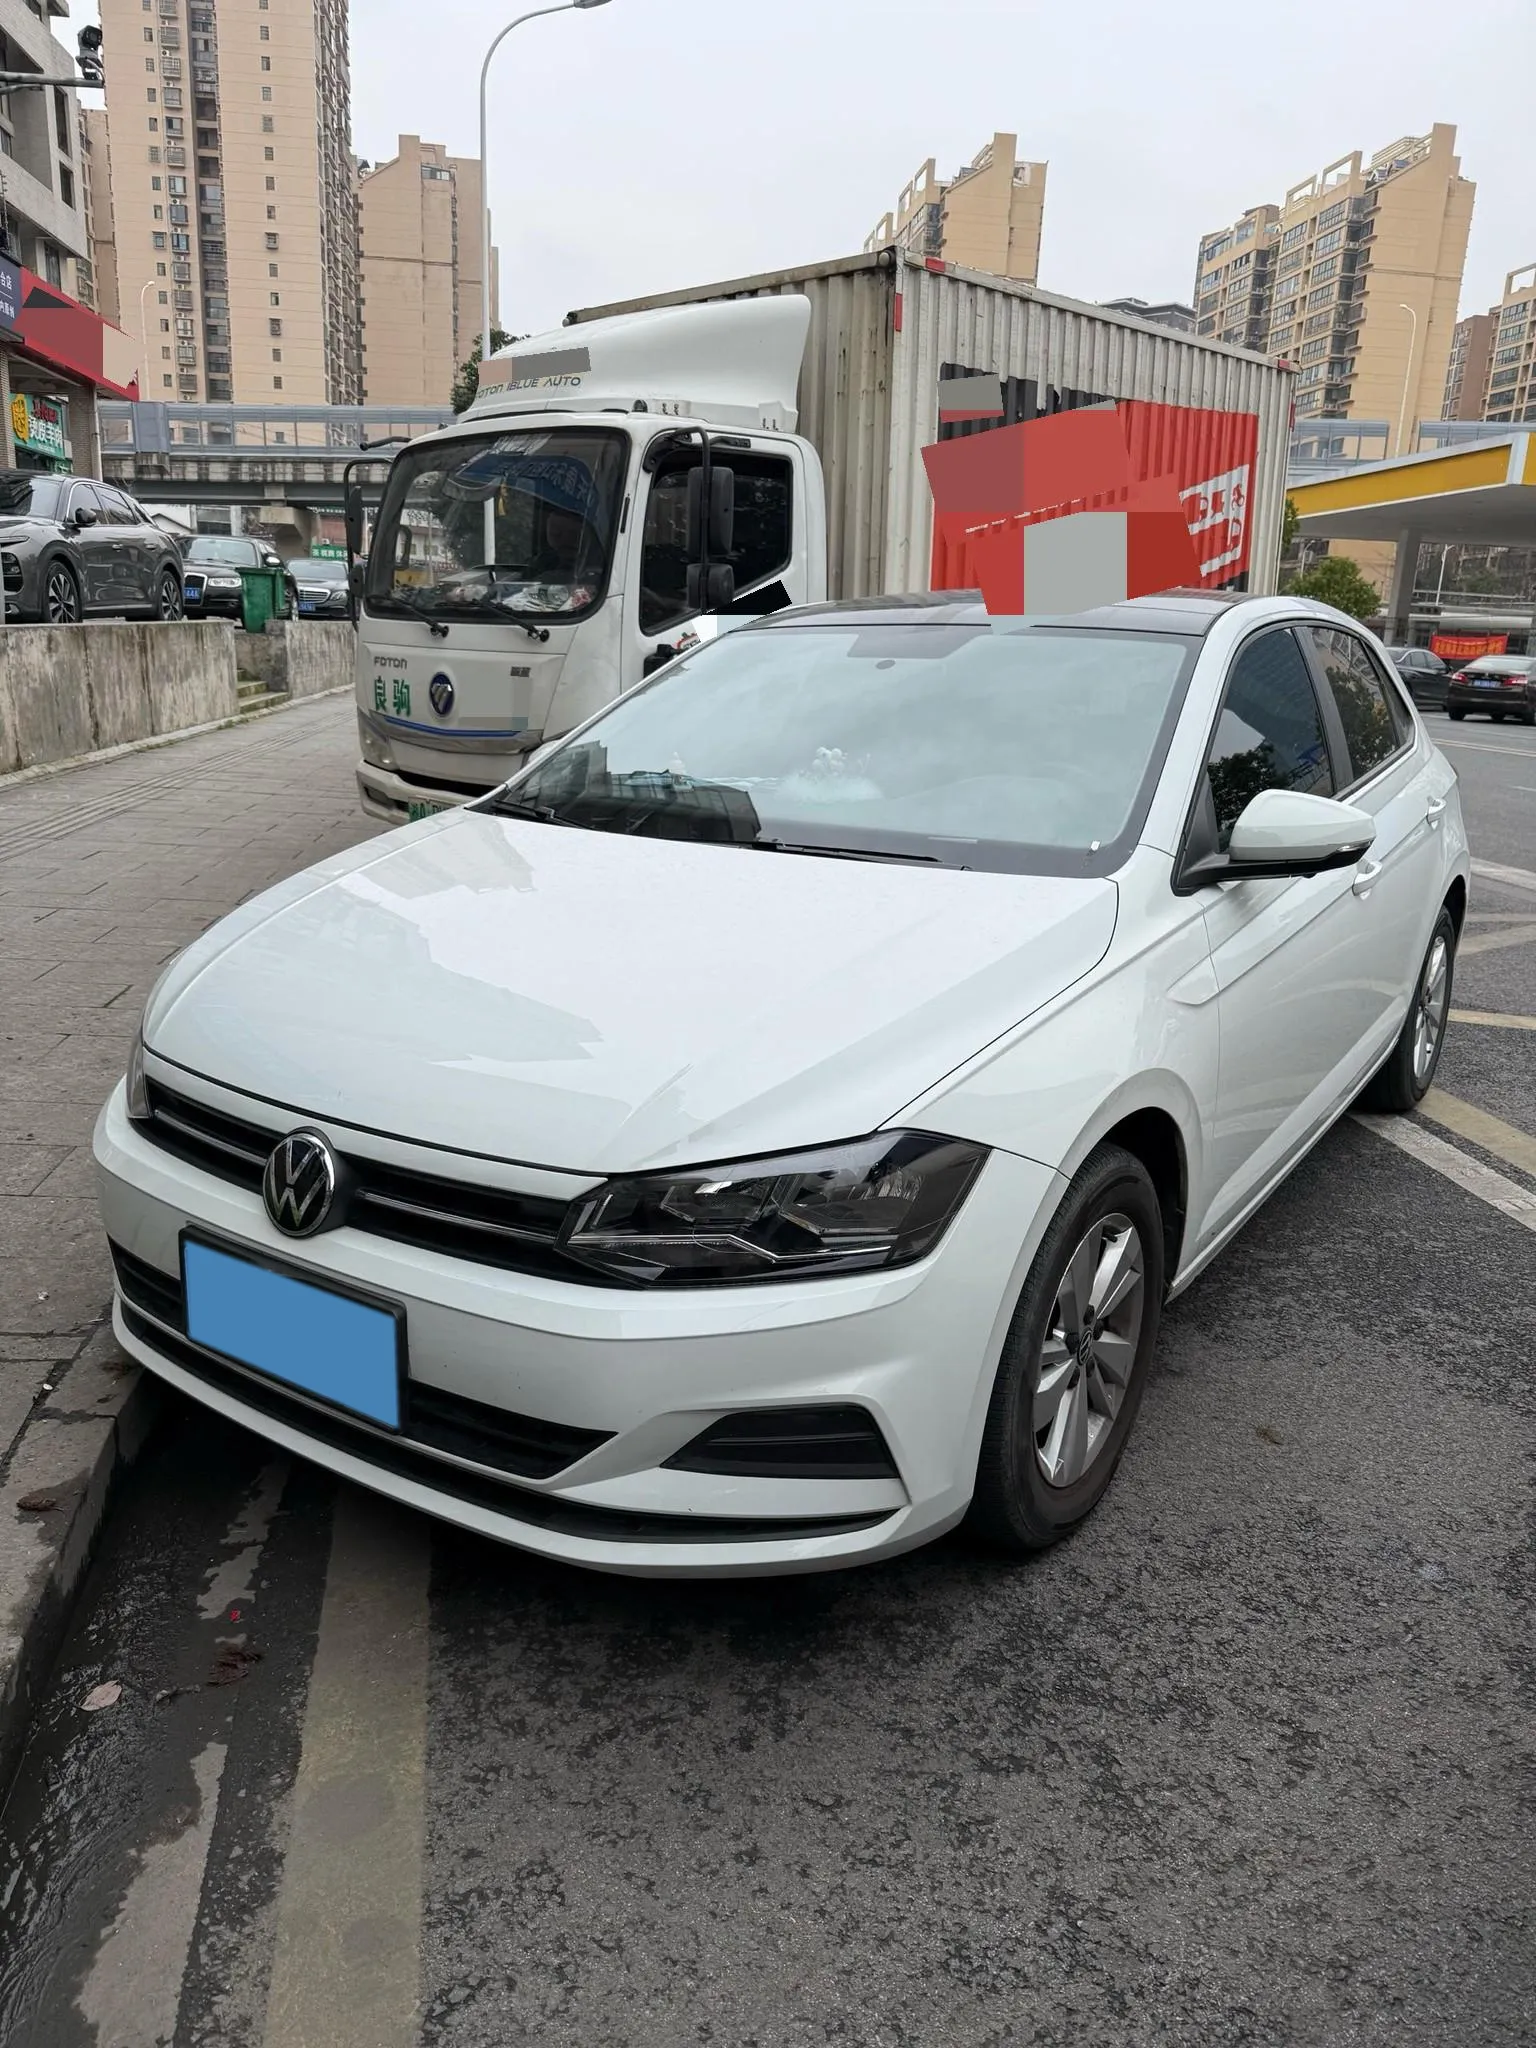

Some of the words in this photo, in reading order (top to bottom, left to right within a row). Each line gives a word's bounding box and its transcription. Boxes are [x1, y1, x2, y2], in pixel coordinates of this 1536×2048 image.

[476, 384, 503, 399] OTON
[544, 376, 581, 387] AUTO
[374, 656, 408, 669] FOTON
